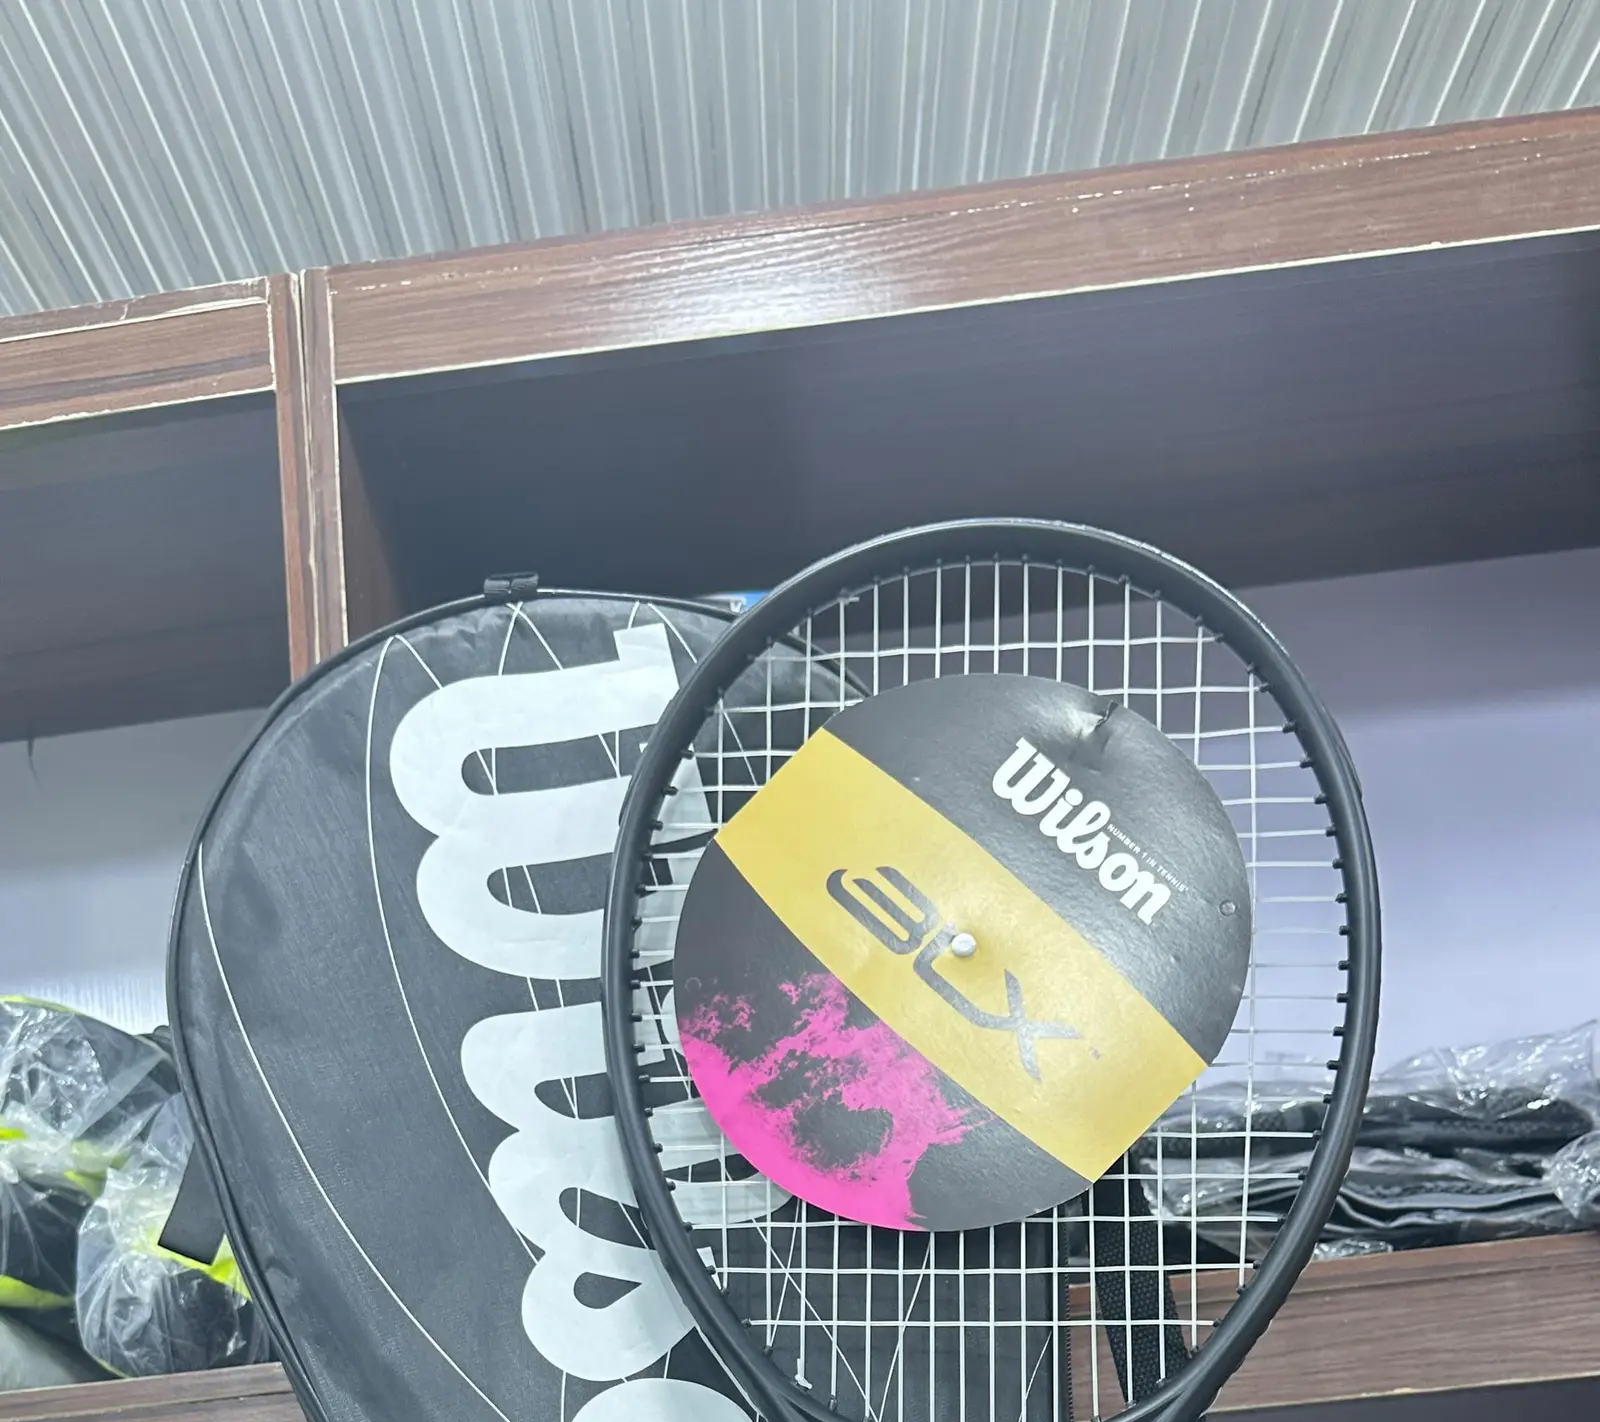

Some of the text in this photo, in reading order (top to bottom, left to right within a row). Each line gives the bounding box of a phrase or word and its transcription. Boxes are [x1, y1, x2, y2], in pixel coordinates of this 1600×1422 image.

[992, 737, 1171, 925] Wilson
[1107, 823, 1141, 854] NUMBER
[1147, 857, 1158, 868] IN
